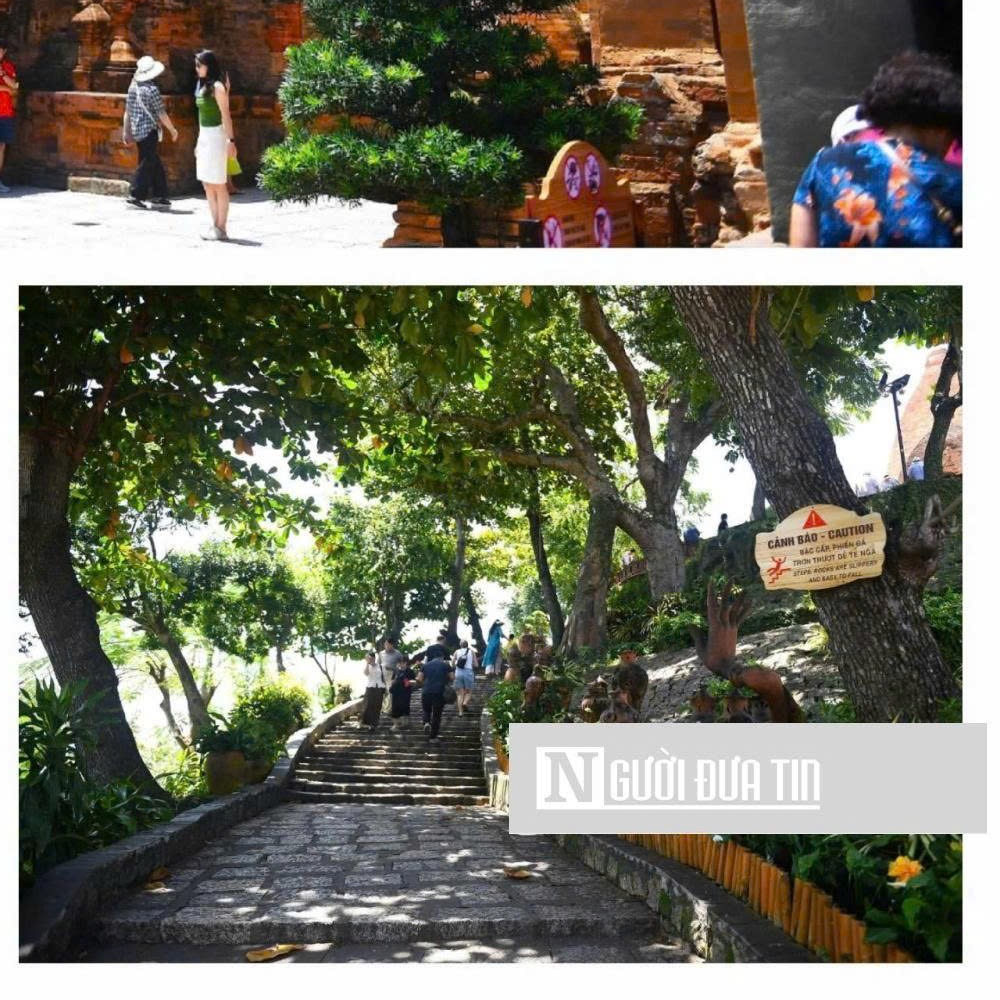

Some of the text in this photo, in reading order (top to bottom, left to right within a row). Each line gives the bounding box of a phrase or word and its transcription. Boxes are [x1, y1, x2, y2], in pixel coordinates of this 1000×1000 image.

[768, 535, 795, 550] CẢNH
[797, 531, 818, 545] BÁO
[828, 523, 874, 539] CAUTION
